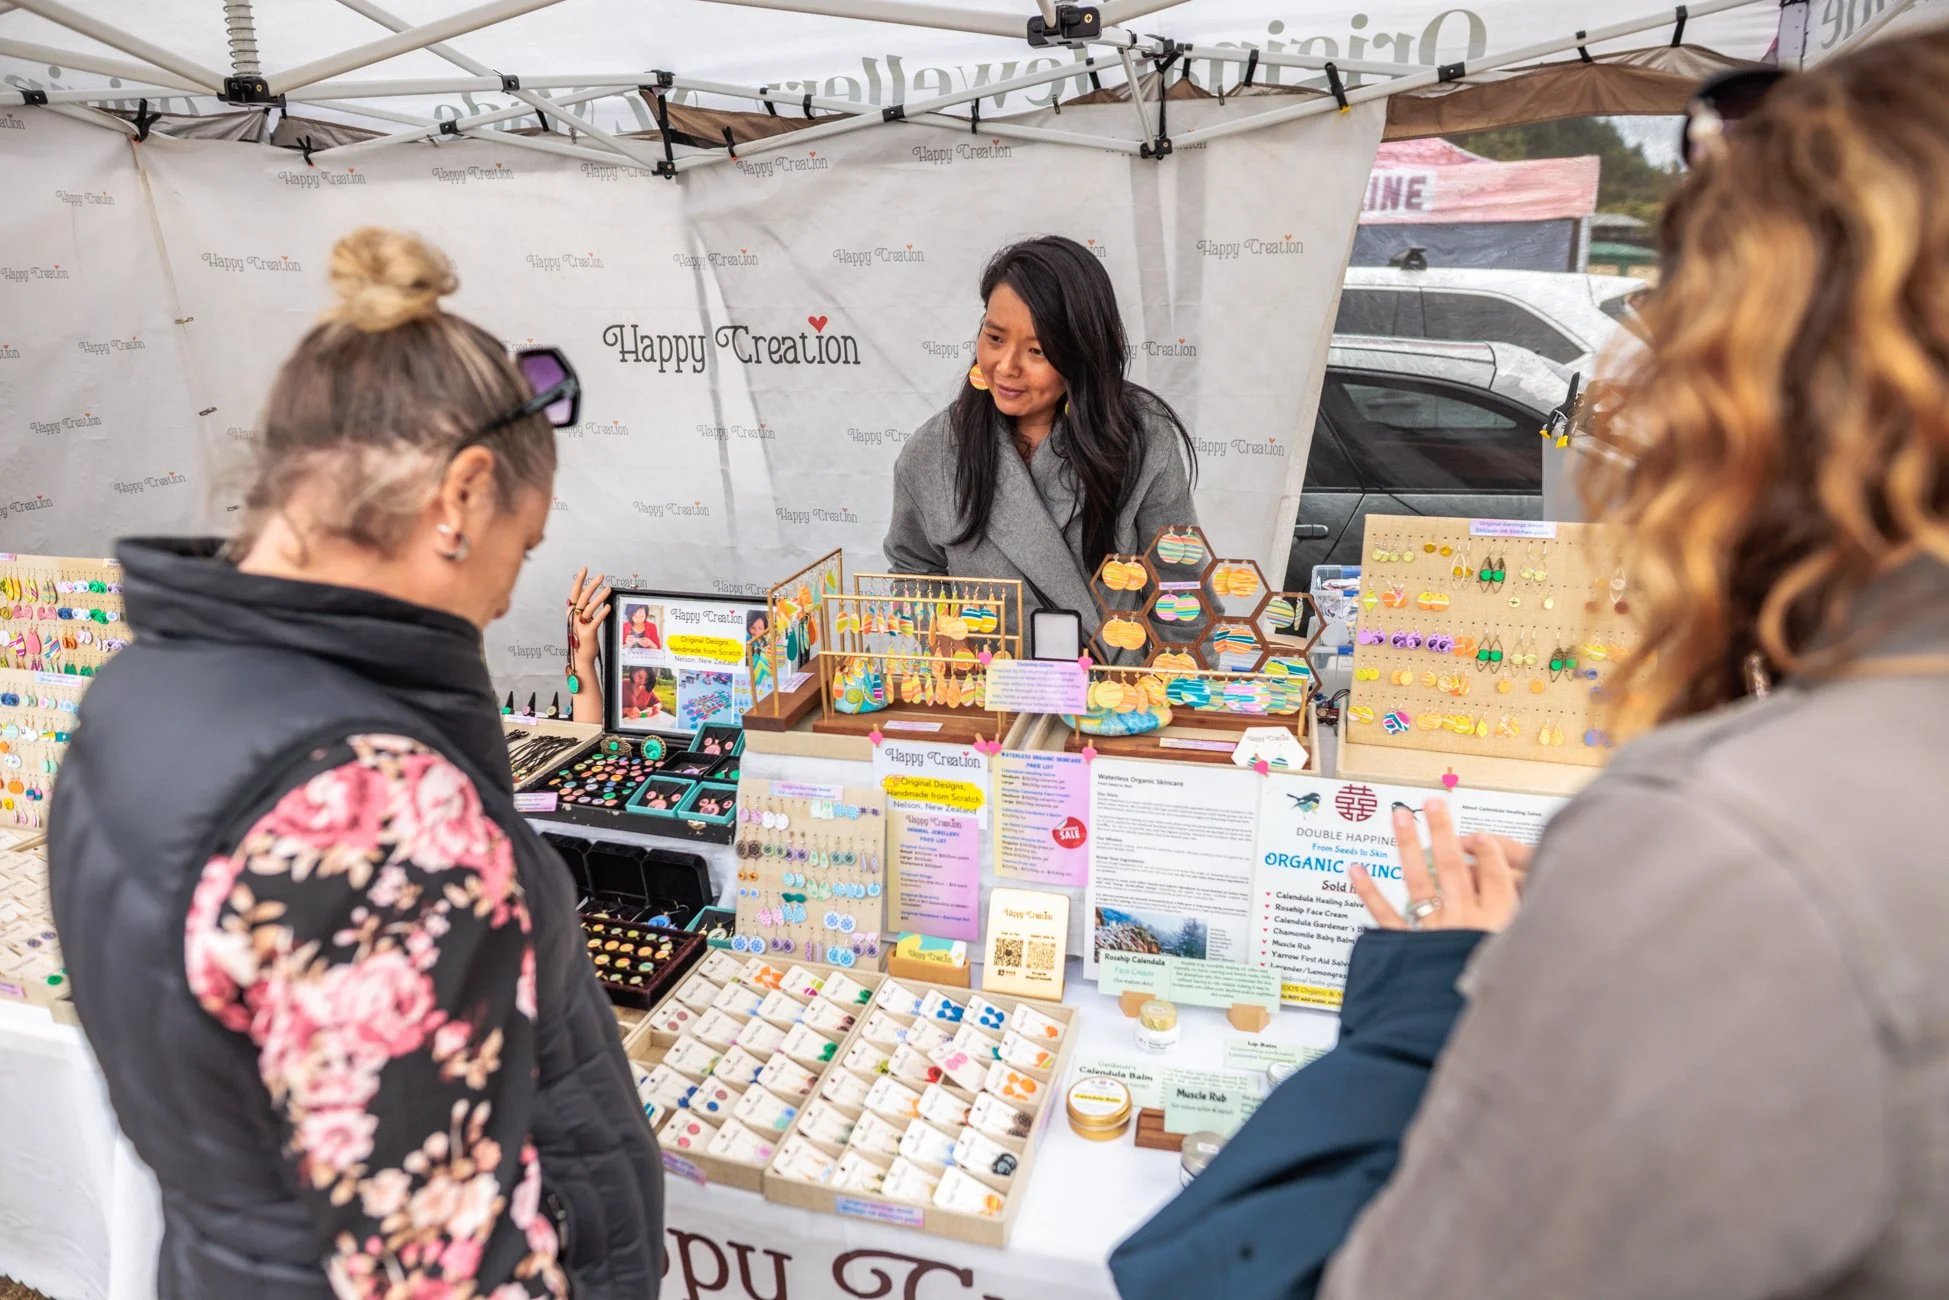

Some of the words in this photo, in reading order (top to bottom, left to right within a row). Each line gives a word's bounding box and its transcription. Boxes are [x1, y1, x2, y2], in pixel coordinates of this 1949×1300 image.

[912, 146, 952, 165] Happy
[955, 143, 1012, 160] Creation
[580, 163, 618, 181] Happy
[737, 160, 773, 177] Happy
[775, 156, 828, 172] Creation
[278, 171, 320, 188] Happy
[321, 171, 366, 185] Creation
[432, 167, 466, 184] Happy
[468, 166, 514, 181] Creation
[1364, 174, 1425, 212] INE
[833, 248, 871, 266] Happy
[874, 247, 924, 263] Creation
[1197, 240, 1240, 259] Happy
[1244, 239, 1304, 255] Creation
[202, 253, 244, 272] Happy
[246, 256, 302, 271] Creation
[527, 255, 560, 271] Happy
[562, 254, 604, 269] Creation
[673, 254, 706, 270] Happy
[708, 253, 759, 266] Creation
[1, 266, 29, 283] Happy
[30, 267, 69, 279] Creation
[79, 341, 110, 356] Happy
[111, 339, 145, 351] Creation
[602, 323, 706, 373] Happy
[715, 325, 861, 365] Creation
[922, 341, 959, 358] Happy
[1142, 341, 1197, 357] Creation
[30, 421, 61, 435] Happy
[62, 416, 101, 429] Creation
[585, 422, 629, 436] Creation
[696, 424, 729, 440] Happy
[731, 424, 775, 440] Creation
[848, 428, 882, 445] Happy
[1231, 439, 1284, 457] Creation
[114, 482, 144, 494] Happy
[144, 473, 186, 488] Creation
[10, 499, 53, 514] Creation
[633, 501, 664, 517] Happy
[666, 501, 710, 517] Creation
[776, 508, 810, 523] Happy
[812, 507, 858, 524] Creation
[713, 580, 744, 596] Happy
[671, 608, 700, 624] Happy
[703, 610, 743, 624] Creation
[680, 636, 704, 645] Original
[508, 645, 542, 659] Happy
[670, 646, 701, 654] Handmade
[703, 648, 718, 656] from
[719, 648, 742, 657] Scratch
[885, 748, 924, 767] Happy
[927, 751, 980, 769] Creation
[901, 777, 932, 788] Original
[1098, 774, 1130, 783] Waterless
[1130, 776, 1155, 786] Organic
[1157, 779, 1185, 788] Skincare
[887, 788, 929, 800] Handmade
[931, 791, 949, 802] from
[951, 793, 980, 804] Scratch
[893, 801, 922, 811] Nelson,
[925, 803, 943, 812] New
[945, 804, 977, 815] Zealand
[1059, 829, 1081, 841] SALE
[1296, 827, 1342, 841] DOUBLE
[1346, 833, 1397, 847] HAPPINE
[1312, 843, 1333, 852] From
[1335, 846, 1358, 856] Seeds
[1360, 847, 1368, 857] to
[1369, 849, 1388, 859] Skin
[1265, 852, 1344, 873] ORGANIC
[1322, 880, 1346, 893] Sold
[1276, 891, 1314, 903] Calendula
[1315, 896, 1343, 907] Healing
[1344, 900, 1365, 909] Salve
[1275, 903, 1305, 914] Rosehip
[1306, 908, 1323, 917] Face
[1325, 910, 1348, 919] Cream
[1274, 916, 1312, 927] Calendula
[1273, 927, 1314, 939] Chamomile
[1316, 933, 1334, 943] Baby
[1272, 939, 1296, 949] Muscle
[1297, 942, 1312, 951] Rub
[1104, 953, 1131, 965] Rosehip
[1132, 955, 1166, 967] Calendula
[1271, 951, 1299, 961] Yarrow
[1301, 954, 1316, 964] First
[1318, 957, 1330, 965] Aid
[1079, 1066, 1126, 1079] Calendula
[1129, 1071, 1153, 1082] Balm
[1176, 1088, 1208, 1102] Muscle
[1209, 1090, 1227, 1103] Rub
